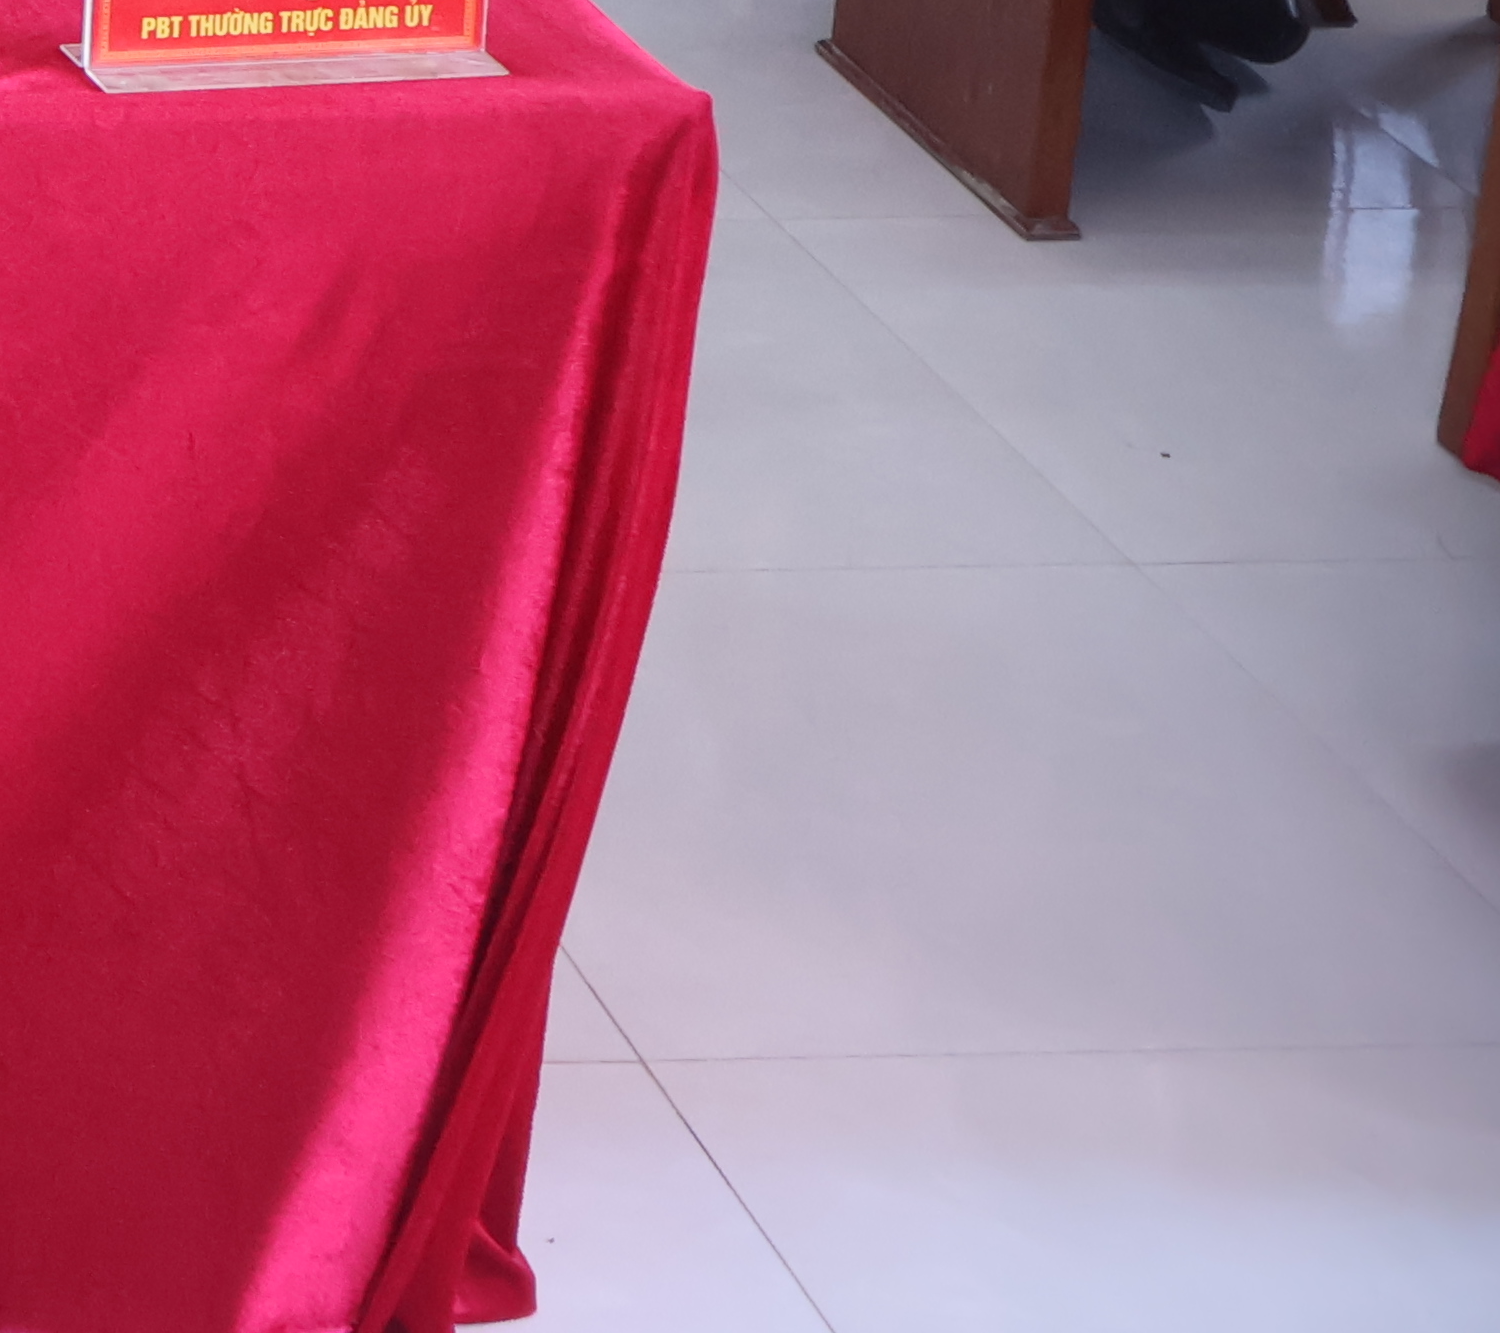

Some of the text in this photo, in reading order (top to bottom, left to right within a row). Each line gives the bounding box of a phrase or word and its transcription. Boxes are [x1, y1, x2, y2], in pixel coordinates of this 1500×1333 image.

[140, 15, 183, 39] PBT
[187, 7, 274, 38] THƯỜNG
[279, 6, 334, 37] TRỰC
[338, 0, 399, 31] ĐẢNG
